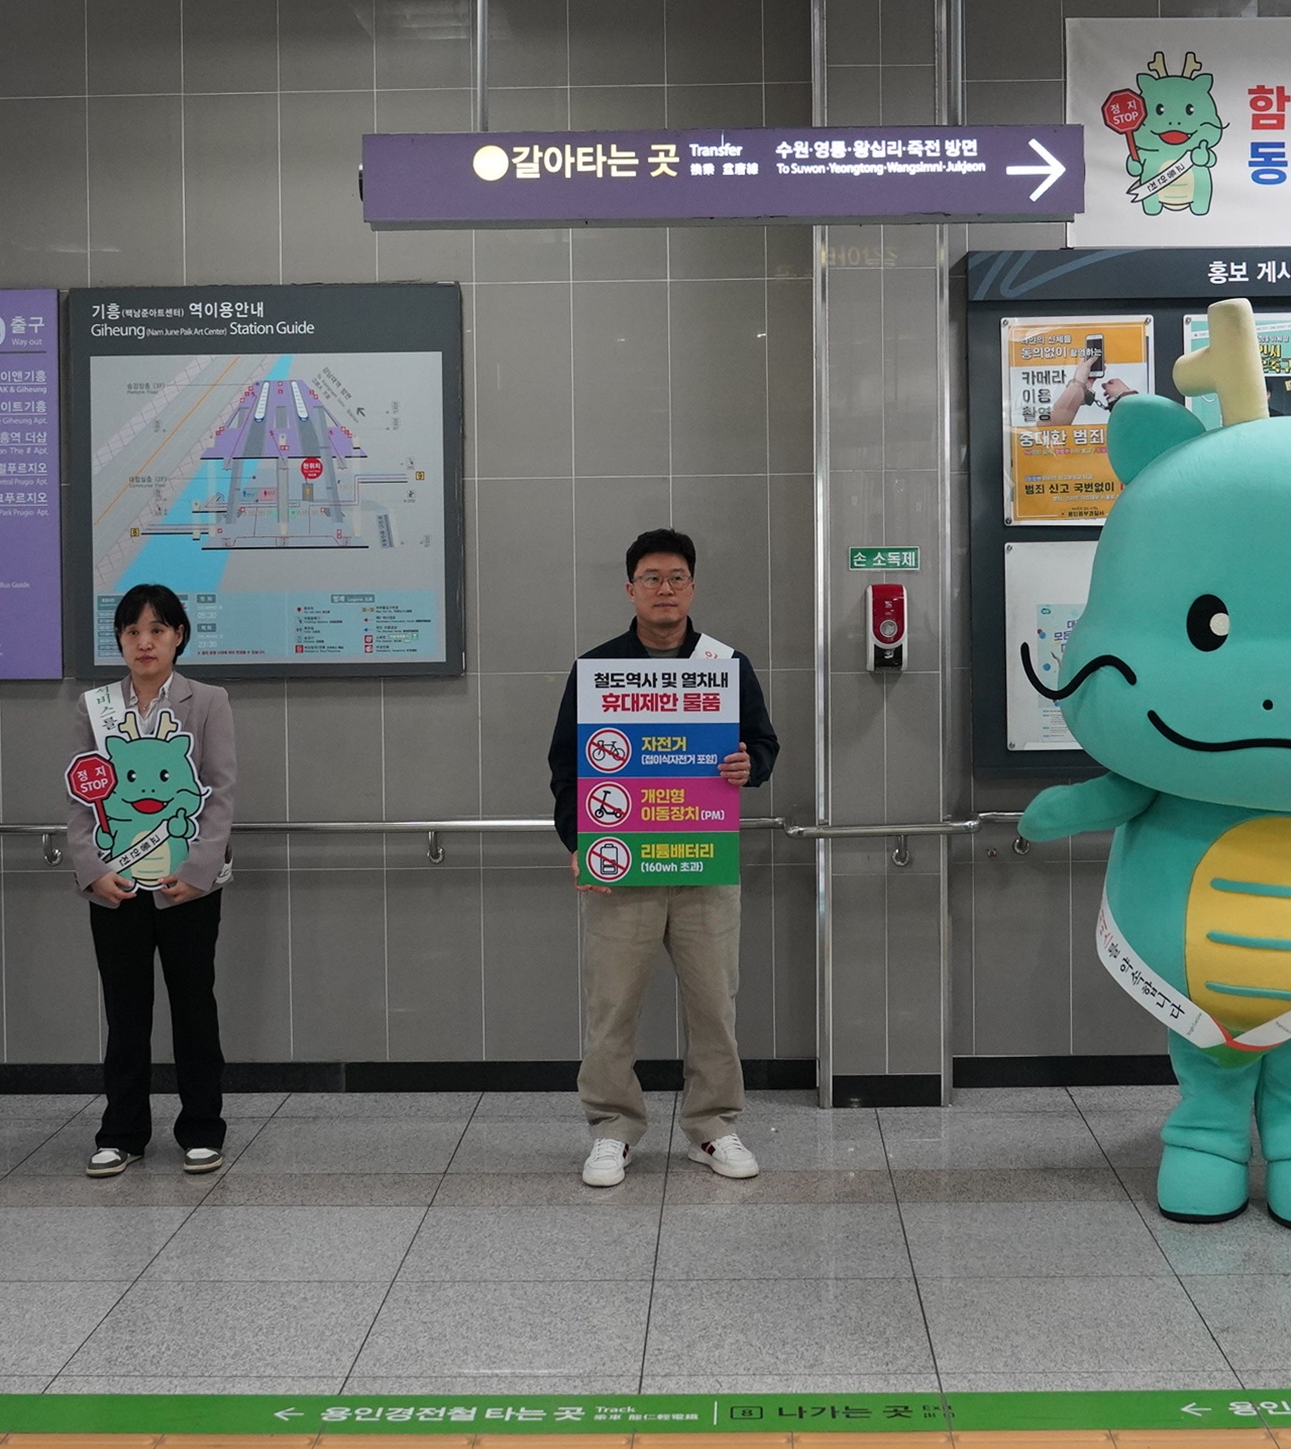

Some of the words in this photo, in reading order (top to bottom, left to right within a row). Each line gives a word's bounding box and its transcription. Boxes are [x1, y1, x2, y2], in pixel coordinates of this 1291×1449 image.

[1113, 110, 1139, 125] STOP
[689, 144, 742, 158] Transfer
[945, 139, 978, 157] 방면
[511, 143, 640, 180] 갈아타는
[647, 143, 680, 179] 곳
[776, 163, 789, 175] To
[1207, 260, 1249, 284] 홍보
[189, 301, 264, 318] 역이용안내
[10, 316, 45, 334] 출구
[91, 323, 145, 339] Giheung
[230, 321, 273, 335] Station
[276, 320, 315, 335] Guide
[11, 338, 27, 346] Way
[1021, 347, 1067, 359] 동의없이
[1022, 370, 1067, 386] 카메라
[1022, 389, 1051, 404] 이용
[25, 432, 47, 444] 더샵
[1019, 430, 1066, 447] 중대한
[1074, 429, 1104, 445] 범죄
[1024, 484, 1045, 494] 범죄
[1049, 483, 1069, 493] 신고
[1074, 482, 1115, 493] 국번없이
[853, 552, 866, 567] 손
[873, 551, 915, 567] 소독제
[595, 673, 657, 688] 철도역사
[661, 673, 677, 688] 및
[682, 673, 728, 688] 열차내
[602, 693, 678, 712] 휴대제한
[683, 693, 720, 712] 물품
[641, 737, 686, 752] 자전거
[641, 754, 695, 765] (접이식자전거
[697, 754, 718, 765] 포함)
[80, 779, 109, 793] STOP
[641, 789, 684, 803] 개인형
[641, 844, 714, 859] 리튬배터리
[641, 861, 677, 872] (160wh
[680, 861, 703, 872] 초과)
[1120, 957, 1187, 1021] 약속합니다
[321, 1406, 477, 1421] 용인경전철
[484, 1407, 546, 1421] 타는
[554, 1406, 585, 1421] 곳
[778, 1405, 872, 1420] 나가는
[883, 1405, 913, 1419] 곳
